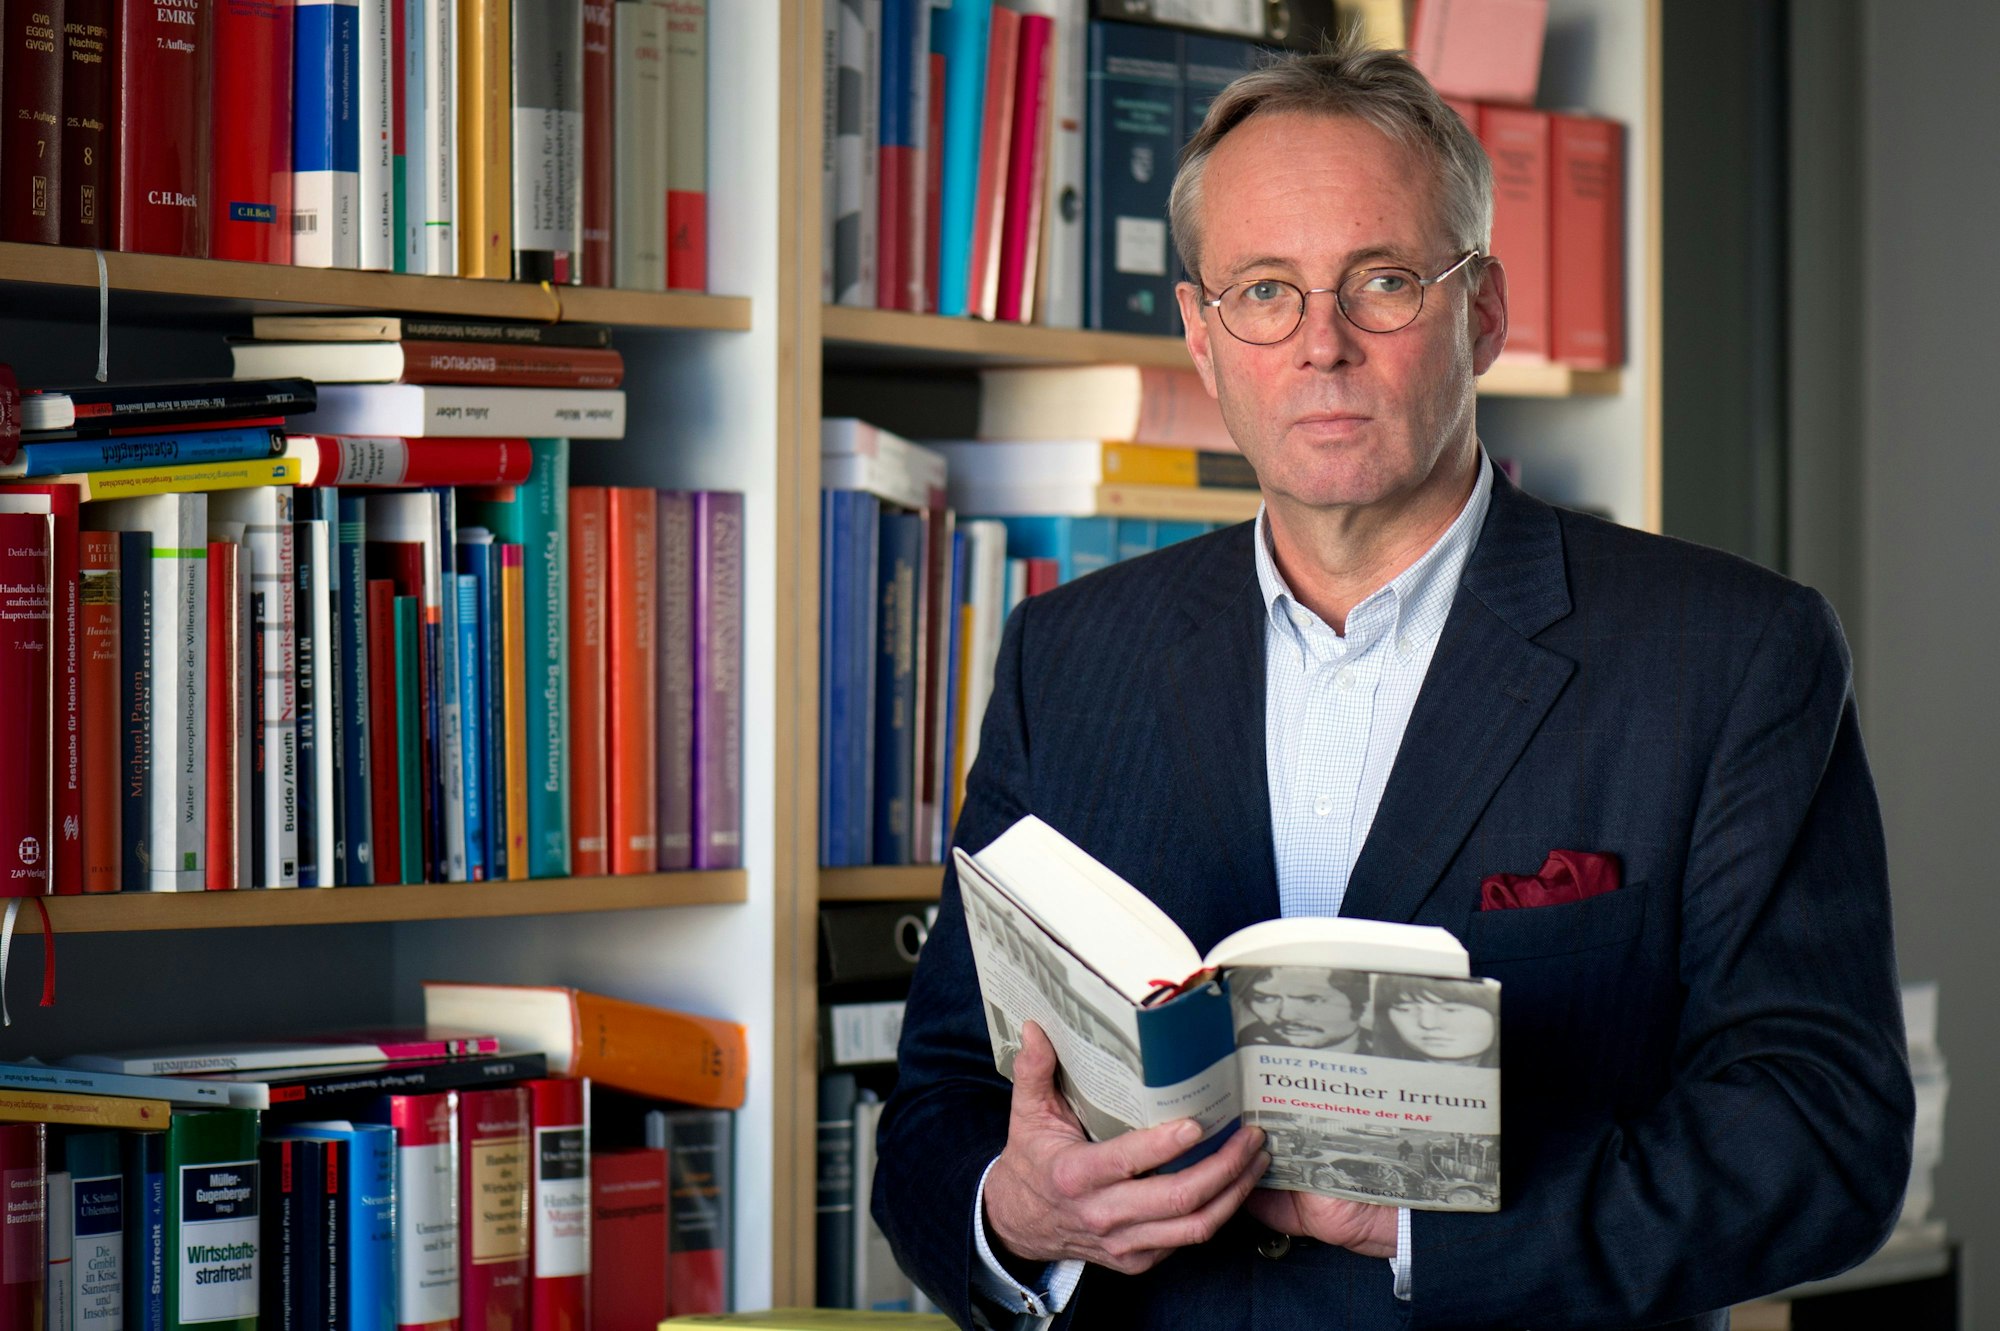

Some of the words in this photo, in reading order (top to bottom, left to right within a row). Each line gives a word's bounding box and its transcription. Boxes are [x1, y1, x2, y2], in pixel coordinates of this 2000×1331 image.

[32, 13, 50, 24] GVG
[157, 8, 196, 26] EMRK
[26, 26, 54, 39] EGGVG
[64, 23, 86, 36] MRK;
[165, 39, 195, 53] Auflage
[19, 110, 32, 120] 25.
[67, 117, 80, 127] 25.
[37, 140, 45, 158] 7
[543, 137, 552, 155] für
[84, 147, 93, 165] 8
[543, 160, 552, 230] Handbuch
[430, 355, 497, 371] EINSPRUCH!
[144, 402, 156, 411] und
[157, 401, 173, 411] Krise
[181, 398, 211, 409] Strafrecht
[436, 407, 463, 420] Leber
[465, 407, 491, 420] Julius
[98, 479, 134, 488] Deutschland
[8, 548, 29, 557] Detlef
[0, 584, 35, 595] Handbuch
[36, 584, 47, 594] für
[545, 531, 559, 659] Psychiatrische
[67, 580, 77, 673] Friebertshäuser
[280, 525, 293, 721] Neurowissenschaften
[143, 589, 151, 678] FREIHEIT?
[21, 641, 44, 652] Auflage
[100, 639, 113, 648] der
[301, 637, 312, 689] MIND
[67, 676, 76, 711] Heino
[131, 671, 143, 722] Pauen
[67, 714, 77, 731] für
[187, 670, 197, 774] Neurophilosophie
[301, 703, 313, 750] TIME
[545, 664, 560, 792] Begutachtung
[67, 734, 77, 789] Festgabe
[284, 732, 293, 776] Meuth
[130, 729, 144, 797] Michael
[186, 784, 194, 823] Walter
[284, 788, 294, 833] Budde
[11, 869, 29, 879] ZAP
[28, 869, 46, 881] Verlag
[152, 1056, 238, 1072] Steuerstrafrecht
[1259, 1073, 1389, 1100] Tödlicher
[1399, 1089, 1488, 1110] Irrtum
[1261, 1095, 1287, 1105] Die
[1290, 1098, 1371, 1116] Geschichte
[1375, 1110, 1399, 1120] der
[1404, 1113, 1433, 1123] RAF
[210, 1173, 241, 1188] Müller-
[152, 1180, 161, 1204] Aufl.
[196, 1187, 251, 1204] Gugenberger
[1349, 1185, 1407, 1199] ARGON
[328, 1199, 336, 1245] Strafrecht
[95, 1246, 110, 1258] Die
[152, 1223, 161, 1295] Strafrecht
[187, 1241, 259, 1264] Wirtschafts-
[328, 1246, 336, 1263] und
[88, 1256, 116, 1270] GmbH
[85, 1271, 95, 1282] in
[195, 1263, 252, 1285] strafrecht
[81, 1283, 121, 1296] Sanierung
[328, 1264, 337, 1323] Unternehmer
[95, 1295, 112, 1306] und
[83, 1307, 120, 1320] Insolvenz
